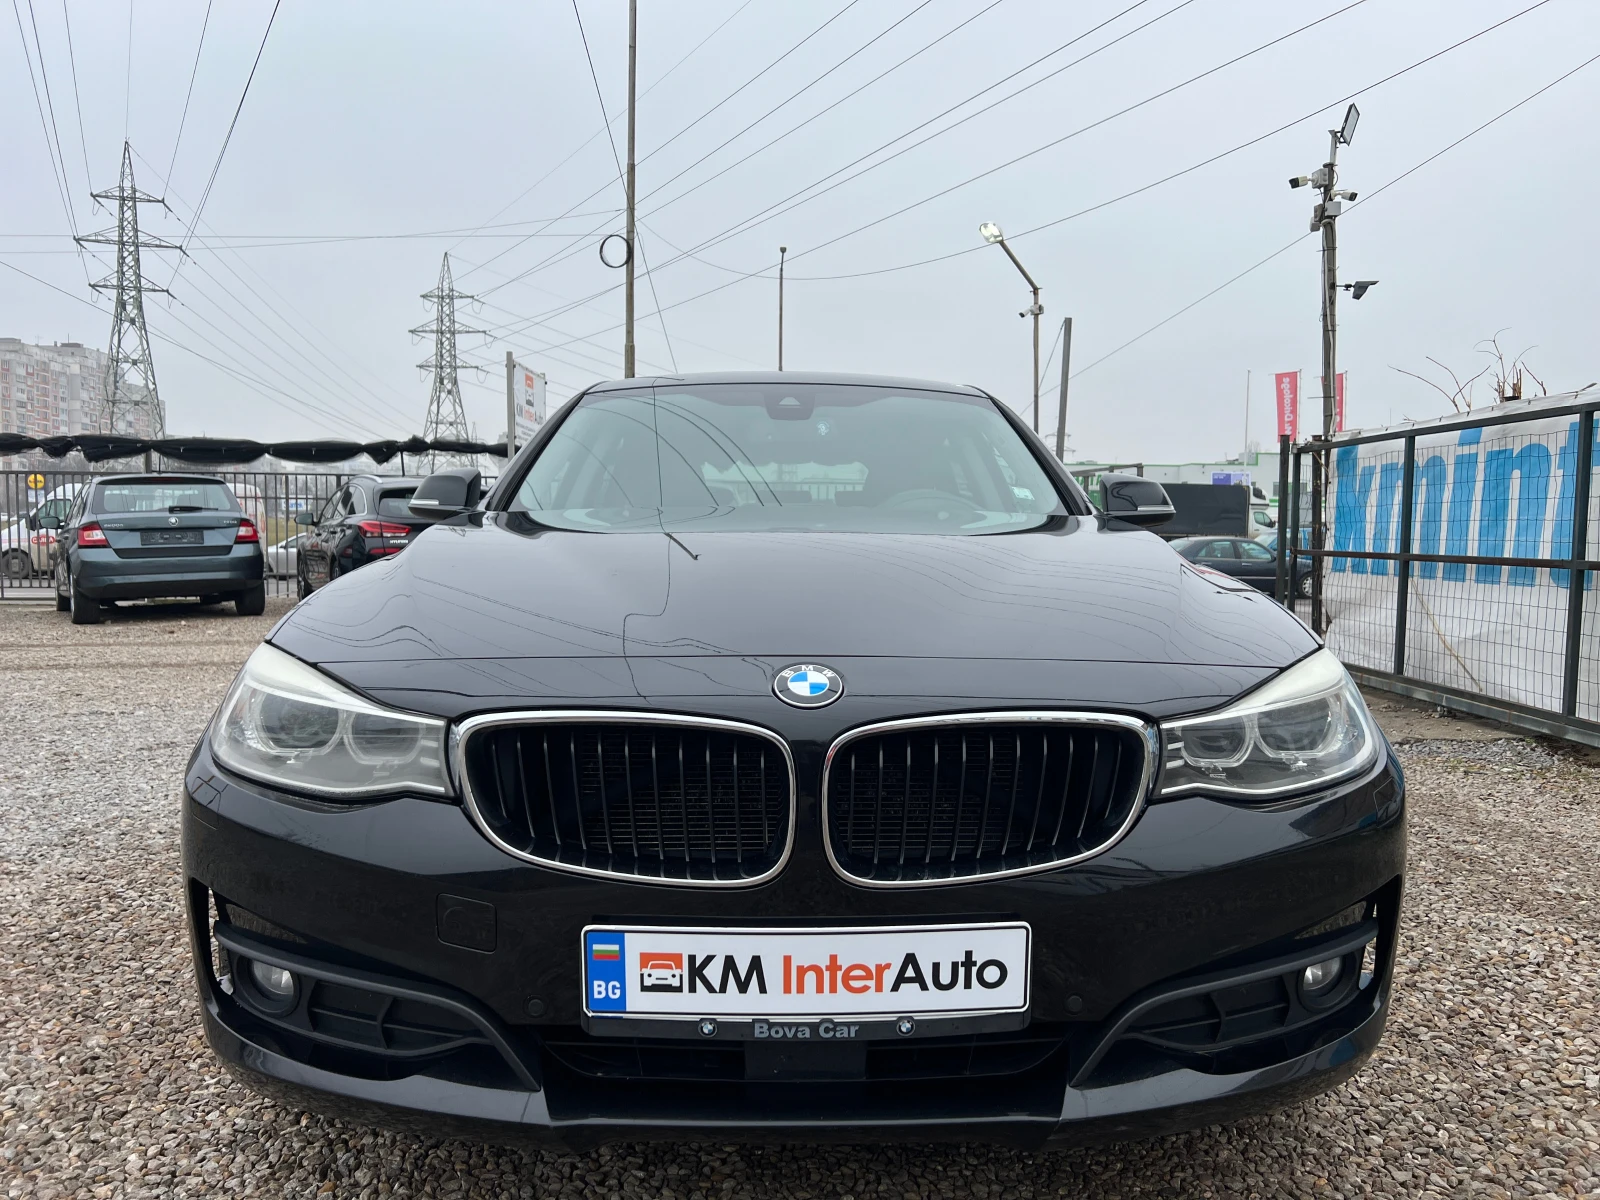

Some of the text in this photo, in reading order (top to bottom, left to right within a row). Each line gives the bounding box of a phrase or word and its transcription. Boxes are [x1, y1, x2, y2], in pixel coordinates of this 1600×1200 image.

[781, 664, 835, 678] BMW
[688, 950, 1008, 994] KM InterAuto
[593, 981, 621, 999] BG
[754, 1022, 860, 1039] Bova Car
